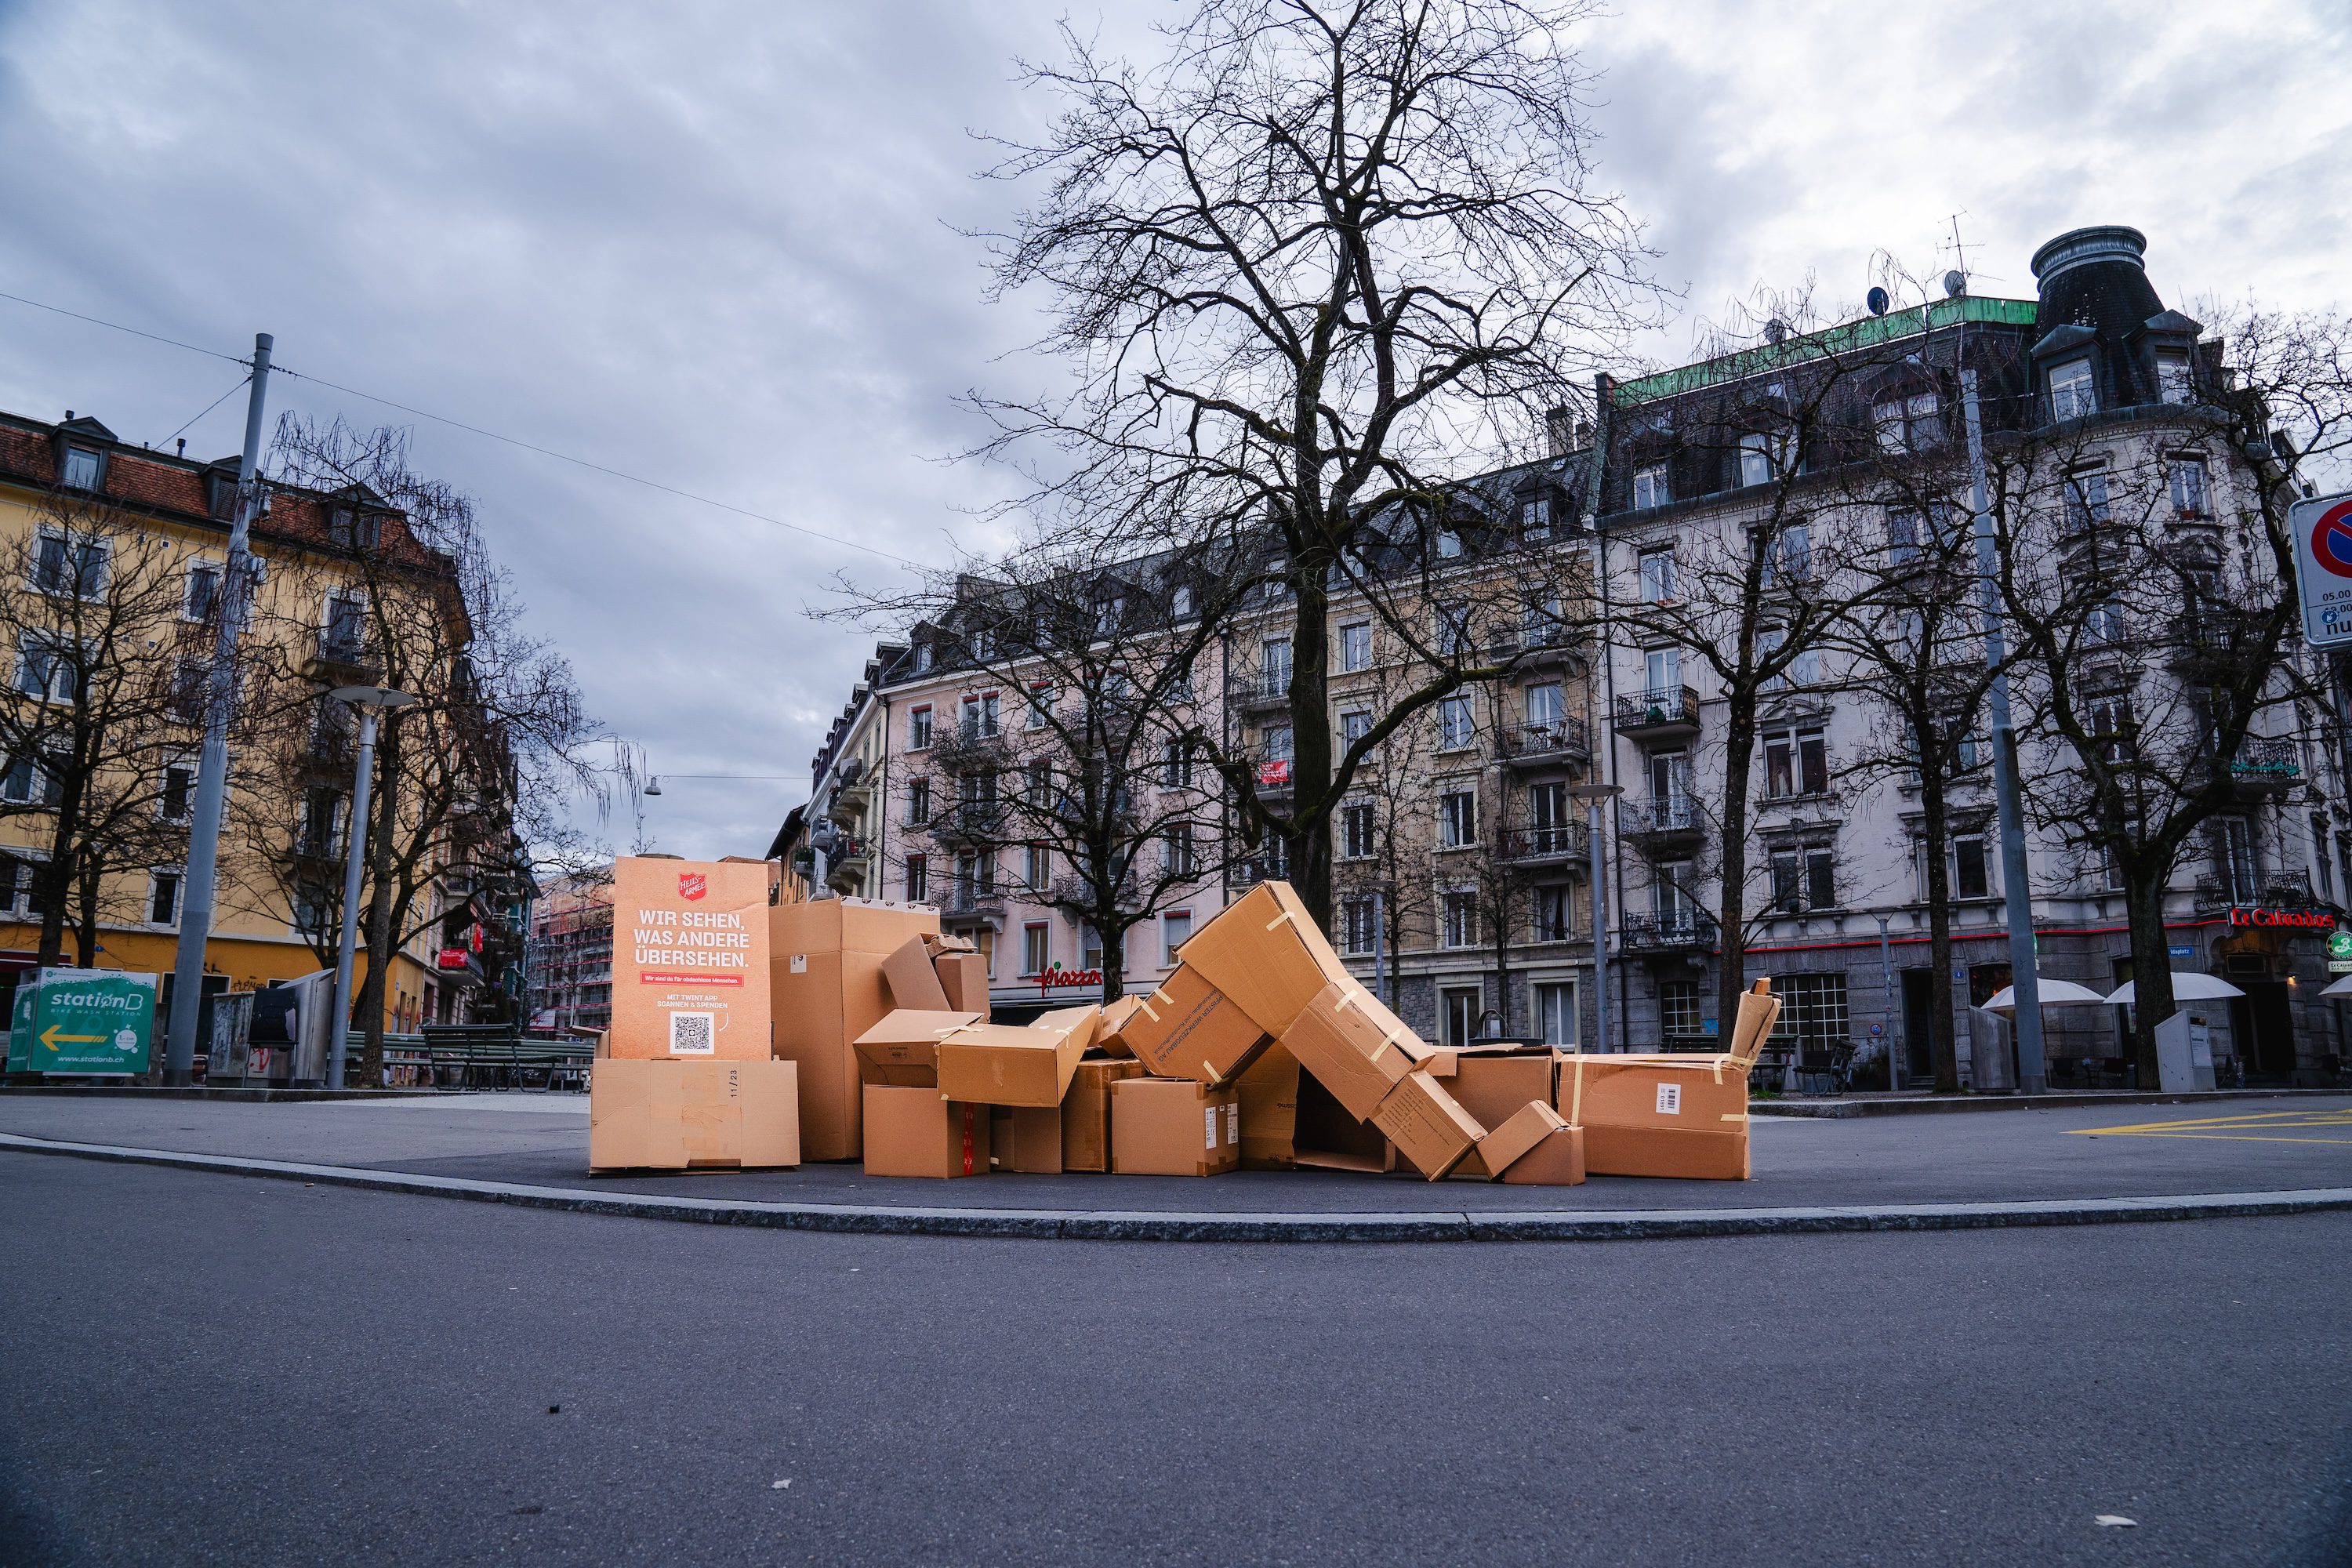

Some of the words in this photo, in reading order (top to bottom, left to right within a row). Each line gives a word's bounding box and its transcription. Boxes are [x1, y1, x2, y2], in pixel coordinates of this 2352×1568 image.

[2322, 590, 2350, 601] 05.00
[680, 876, 702, 891] HEILS-
[684, 881, 706, 898] ARMEE
[639, 909, 677, 926] WIR
[682, 911, 745, 931] SEHEN,
[2231, 908, 2250, 926] Le
[2252, 908, 2335, 927] Calvados
[633, 928, 673, 946] WAS
[677, 931, 750, 948] ANDERE
[635, 945, 749, 967] ÜBERSEHEN.
[1192, 988, 1218, 1015] Werkzeugbau
[1203, 994, 1224, 1017] PFISTER
[1166, 1015, 1203, 1054] WERKZEUGBAU
[1158, 1053, 1167, 1062] AG
[729, 1070, 738, 1098] 11/23
